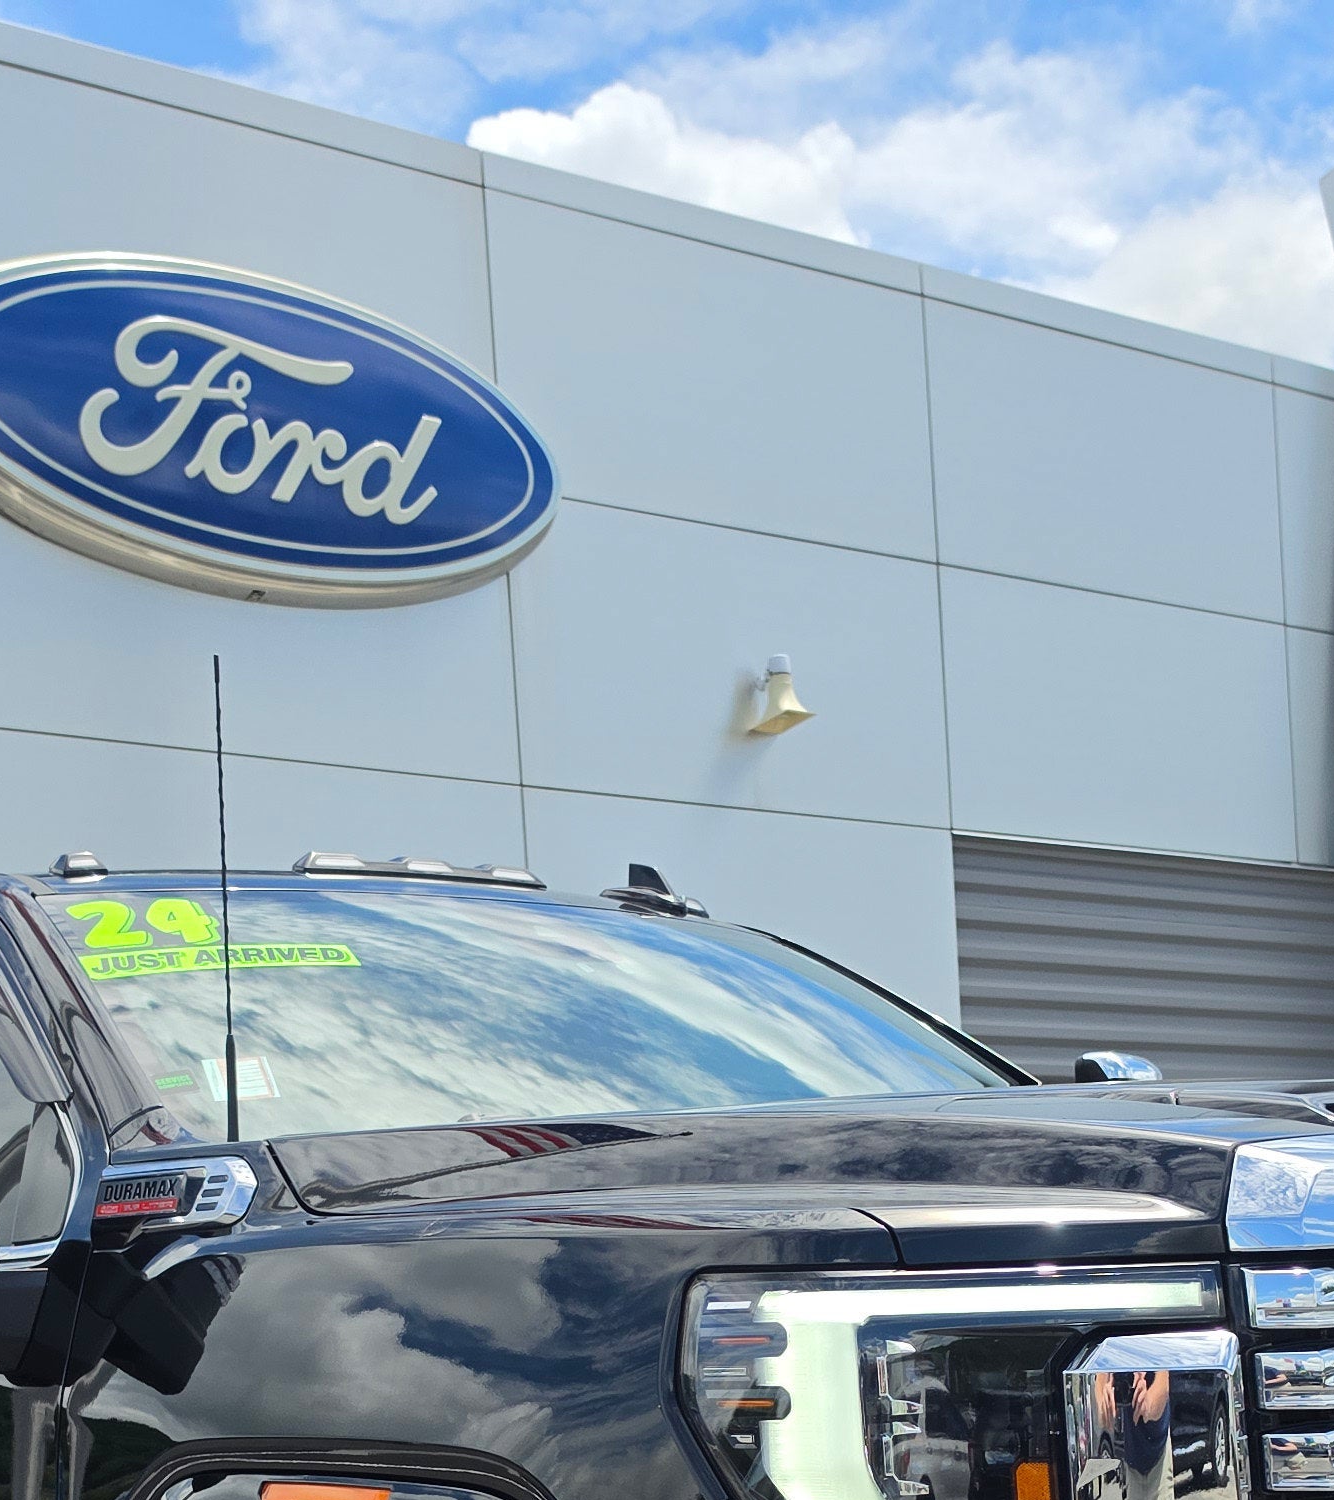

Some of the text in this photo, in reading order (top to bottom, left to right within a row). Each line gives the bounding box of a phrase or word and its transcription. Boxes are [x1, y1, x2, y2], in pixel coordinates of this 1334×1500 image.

[79, 314, 442, 525] Ford
[66, 897, 222, 949] 24
[91, 946, 353, 977] JUST ARRIVED
[103, 1178, 178, 1202] DURAMAX
